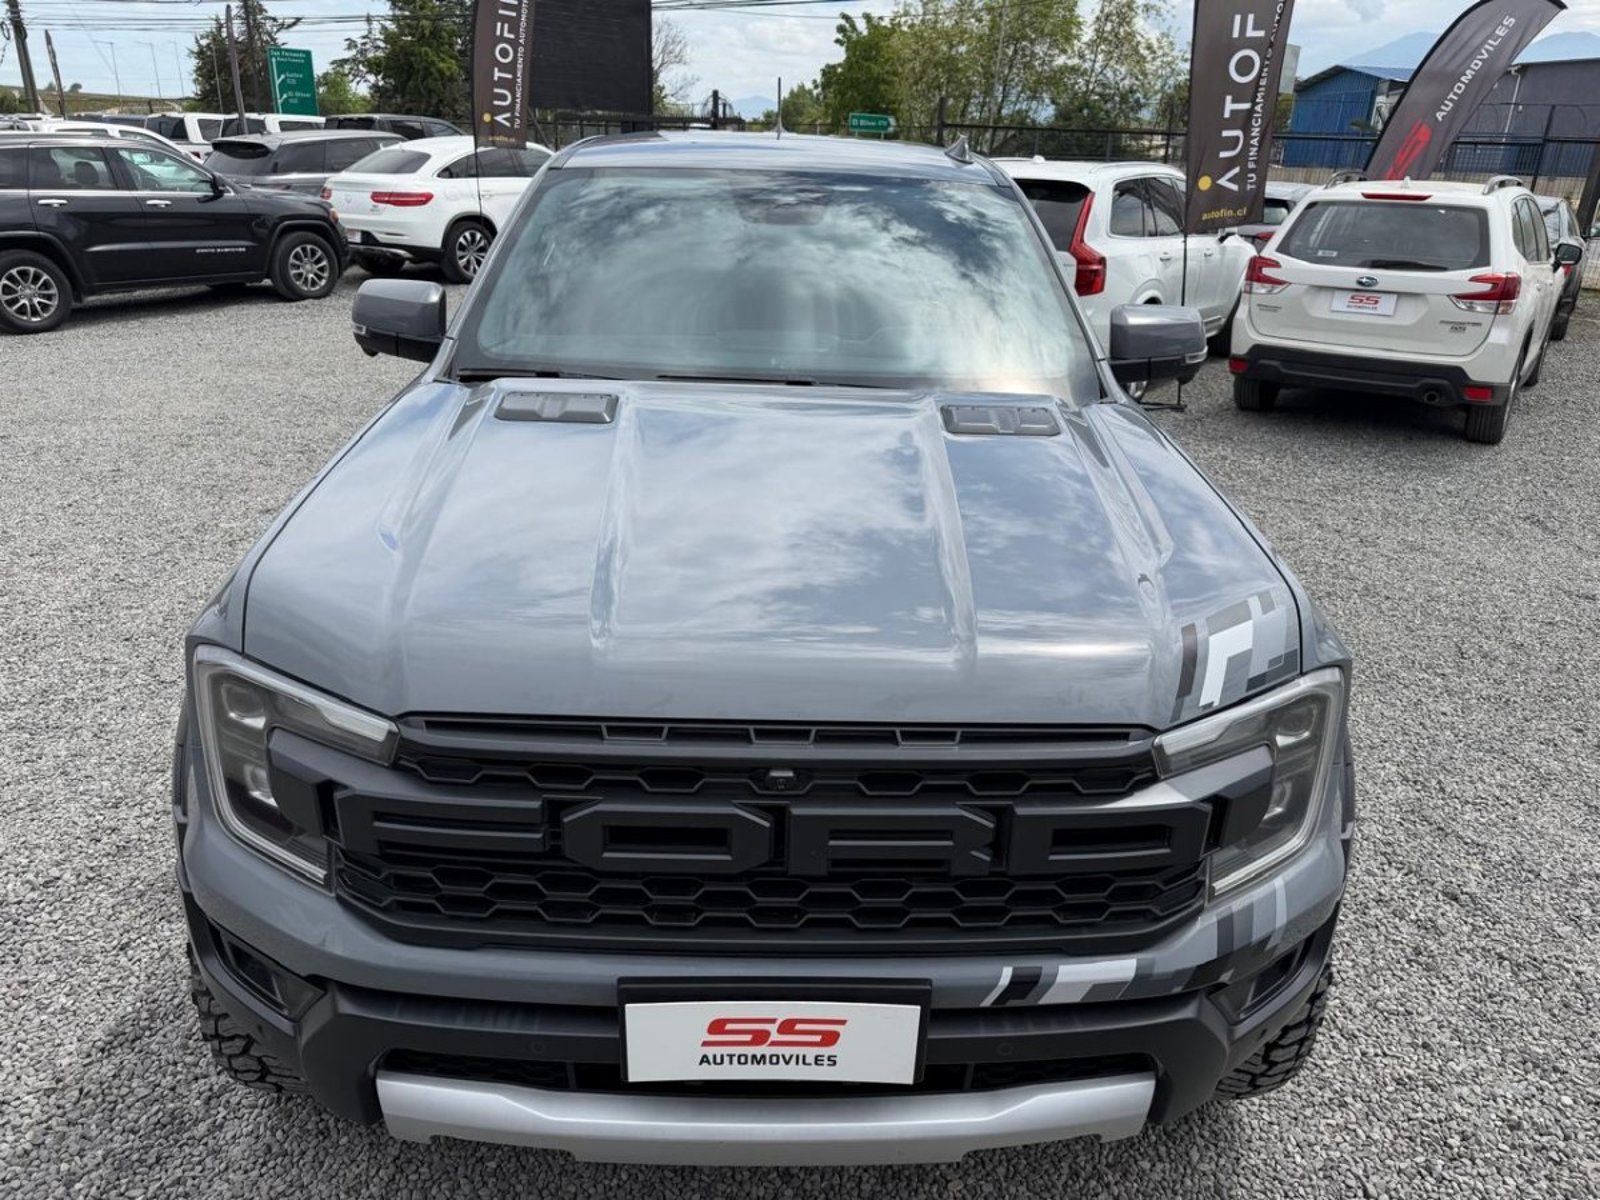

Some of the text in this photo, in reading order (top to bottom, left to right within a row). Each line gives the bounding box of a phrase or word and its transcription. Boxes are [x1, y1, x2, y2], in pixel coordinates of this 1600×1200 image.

[514, 46, 525, 117] FINANCIAMIENTO
[1435, 15, 1516, 122] AUTOMOVILES
[1216, 13, 1266, 191] AUTOF
[1247, 0, 1285, 191] TU FINANCIAMIENTO AUTO
[514, 118, 521, 129] TU
[1201, 206, 1248, 221] autofin.cl
[1347, 294, 1382, 305] SS
[333, 790, 1213, 878] FORD
[701, 1017, 849, 1048] SS
[698, 1053, 838, 1067] AUTOMOVILES
